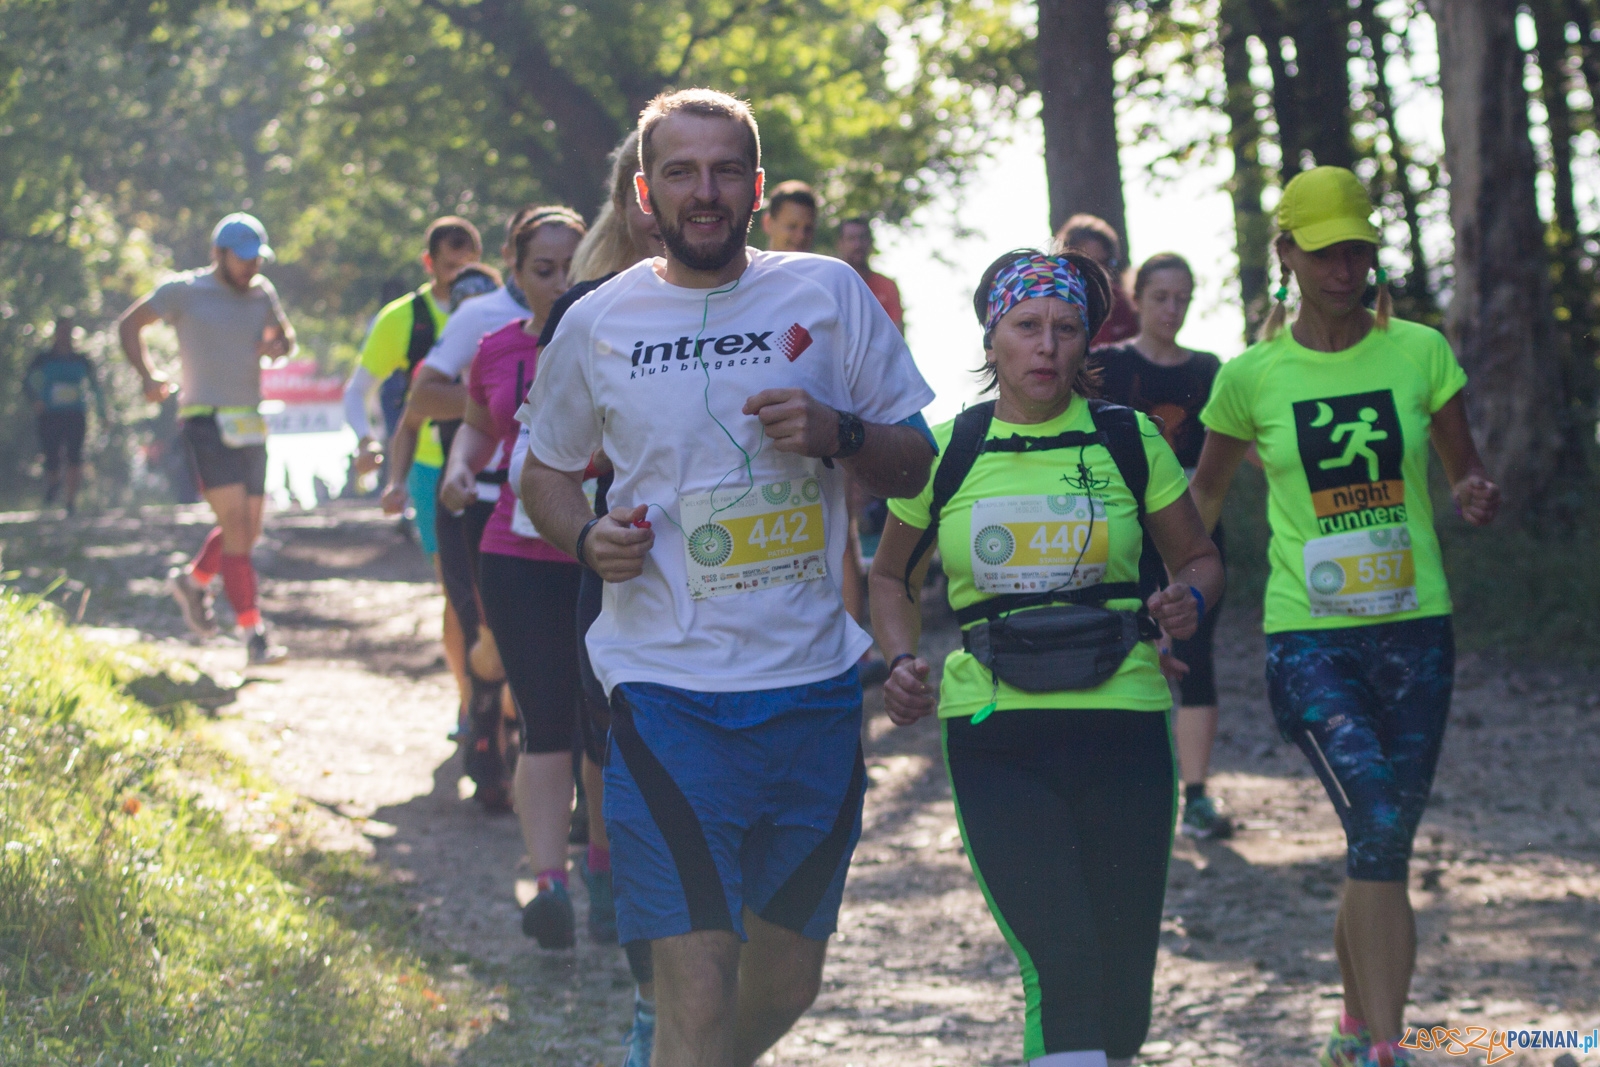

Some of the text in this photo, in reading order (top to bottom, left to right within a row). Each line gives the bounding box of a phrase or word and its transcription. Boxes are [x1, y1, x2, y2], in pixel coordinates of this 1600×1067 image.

[631, 331, 775, 367] intrex
[630, 355, 772, 380] klub biegacza
[1333, 482, 1391, 508] night
[747, 511, 809, 549] 442
[1319, 504, 1407, 534] runners
[767, 546, 795, 558] PATRYK
[1029, 524, 1092, 555] 440
[1358, 554, 1404, 583] 557
